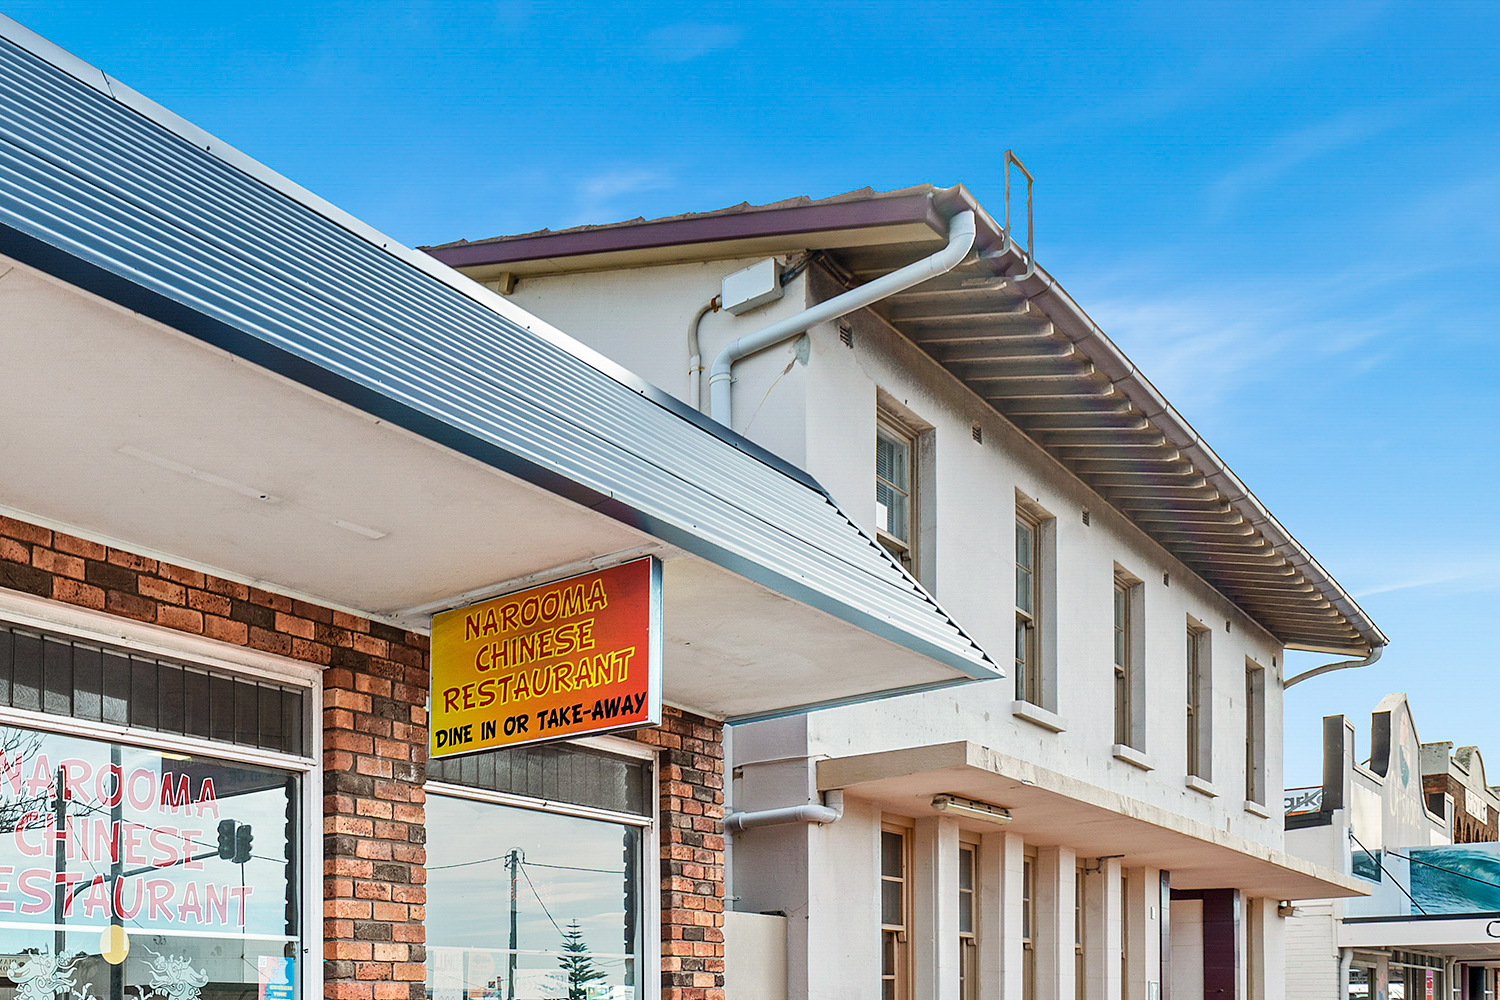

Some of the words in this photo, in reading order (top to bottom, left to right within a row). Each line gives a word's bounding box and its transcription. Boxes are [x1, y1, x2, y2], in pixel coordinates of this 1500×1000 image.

[464, 578, 608, 642] NAROOMA
[474, 618, 595, 674] CHINESE
[443, 647, 635, 714] RESTAURANT
[435, 724, 473, 749] DINE
[481, 720, 497, 741] IN
[503, 714, 529, 736] OR
[537, 691, 647, 730] TAKE-AWAY
[14, 811, 205, 871] CHINESE
